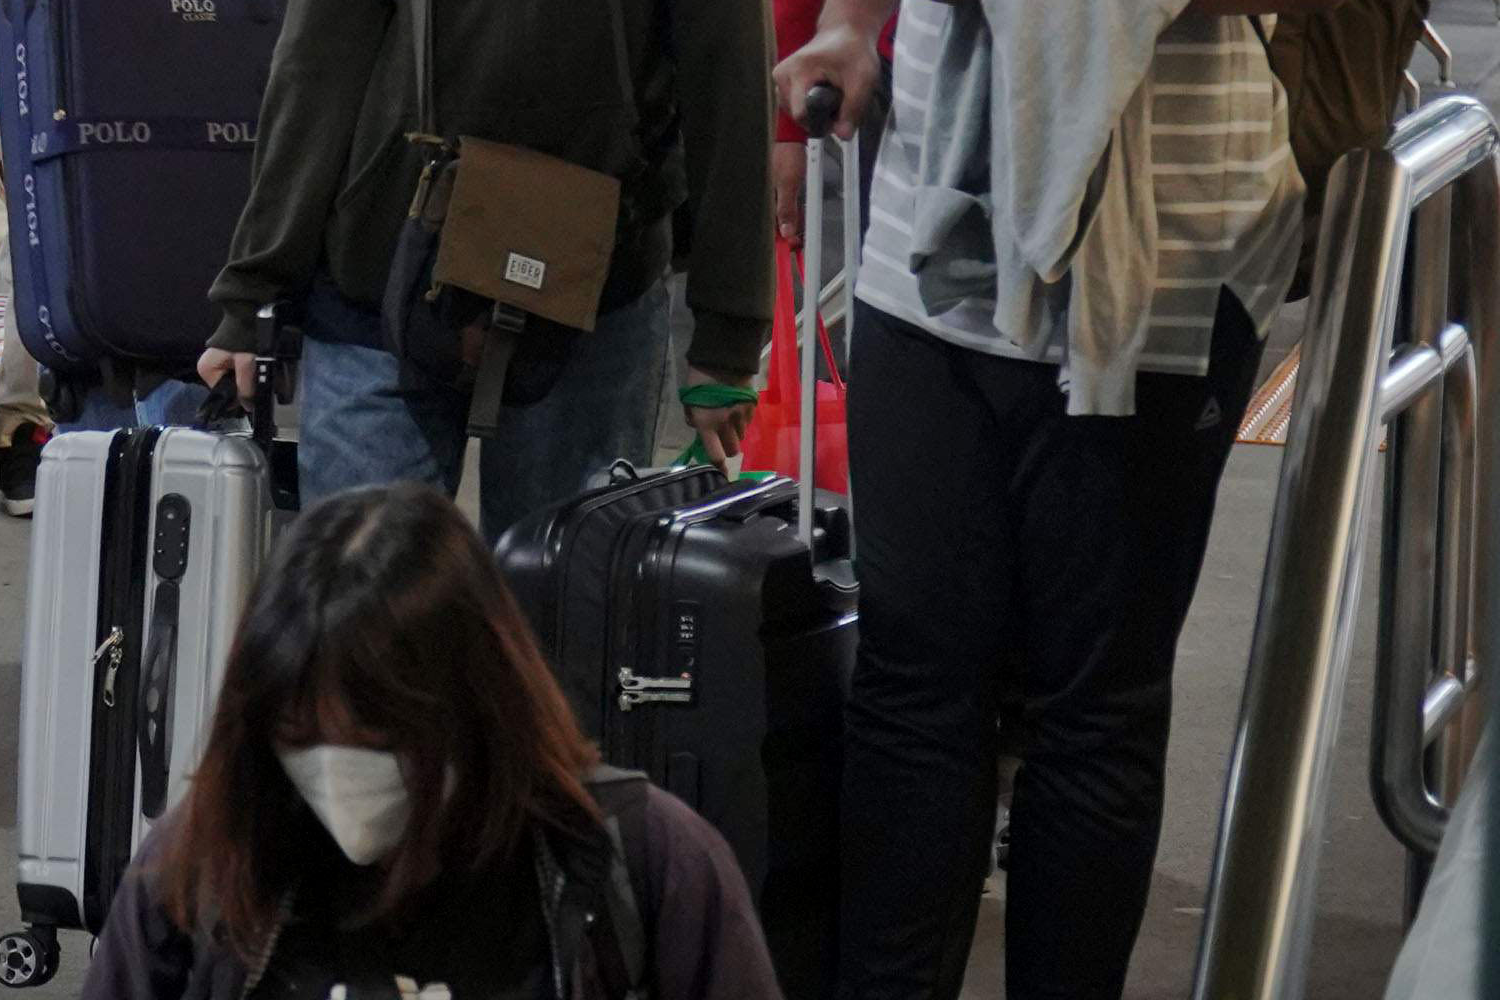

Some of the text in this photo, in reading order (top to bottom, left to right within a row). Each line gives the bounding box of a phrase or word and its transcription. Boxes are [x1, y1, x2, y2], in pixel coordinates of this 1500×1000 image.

[170, 0, 215, 12] POLO
[16, 43, 29, 117] POLO
[78, 121, 259, 145] POLO POL
[24, 174, 40, 246] POLO
